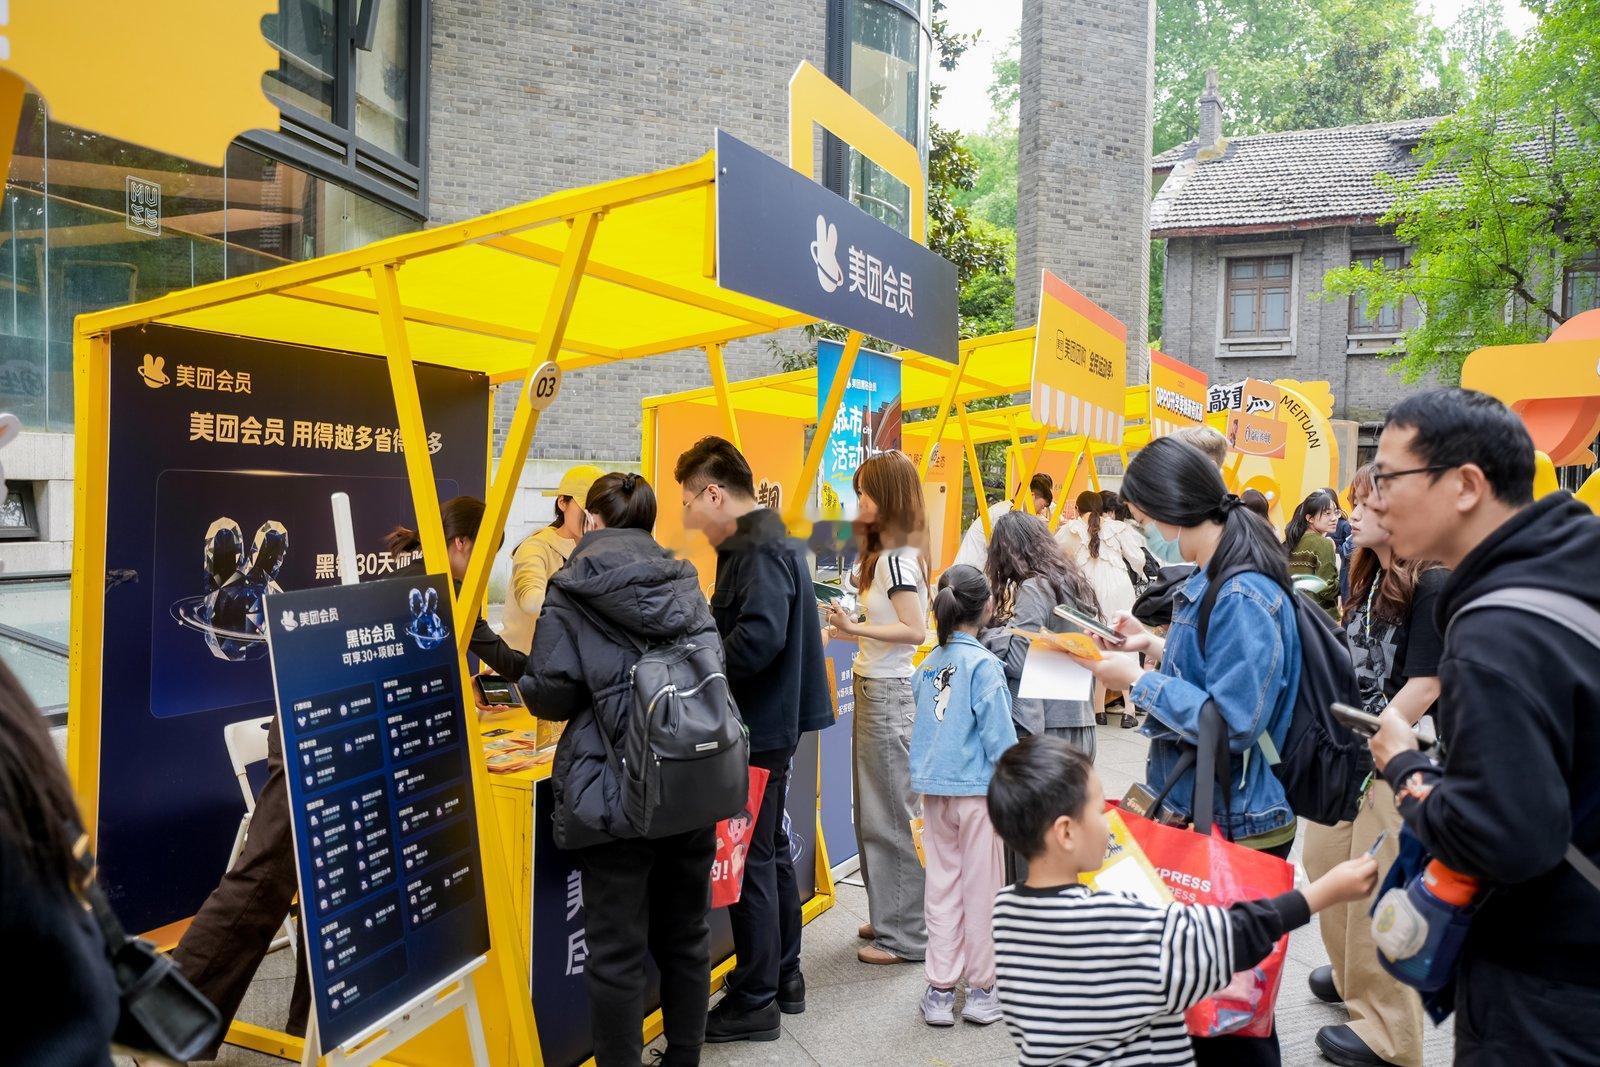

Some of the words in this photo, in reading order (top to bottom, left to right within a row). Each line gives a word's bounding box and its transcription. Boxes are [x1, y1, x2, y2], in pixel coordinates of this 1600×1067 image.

[848, 245, 914, 318] 美团会员
[176, 364, 252, 394] 美团会员
[536, 376, 556, 398] 03
[189, 411, 285, 447] 美团会员
[292, 420, 443, 455] 用得越多省得多
[1279, 395, 1321, 449] MEITUAN
[299, 608, 340, 627] 美团会员
[346, 623, 396, 649] 黑钻会员
[342, 643, 405, 667] 可享30+项权益
